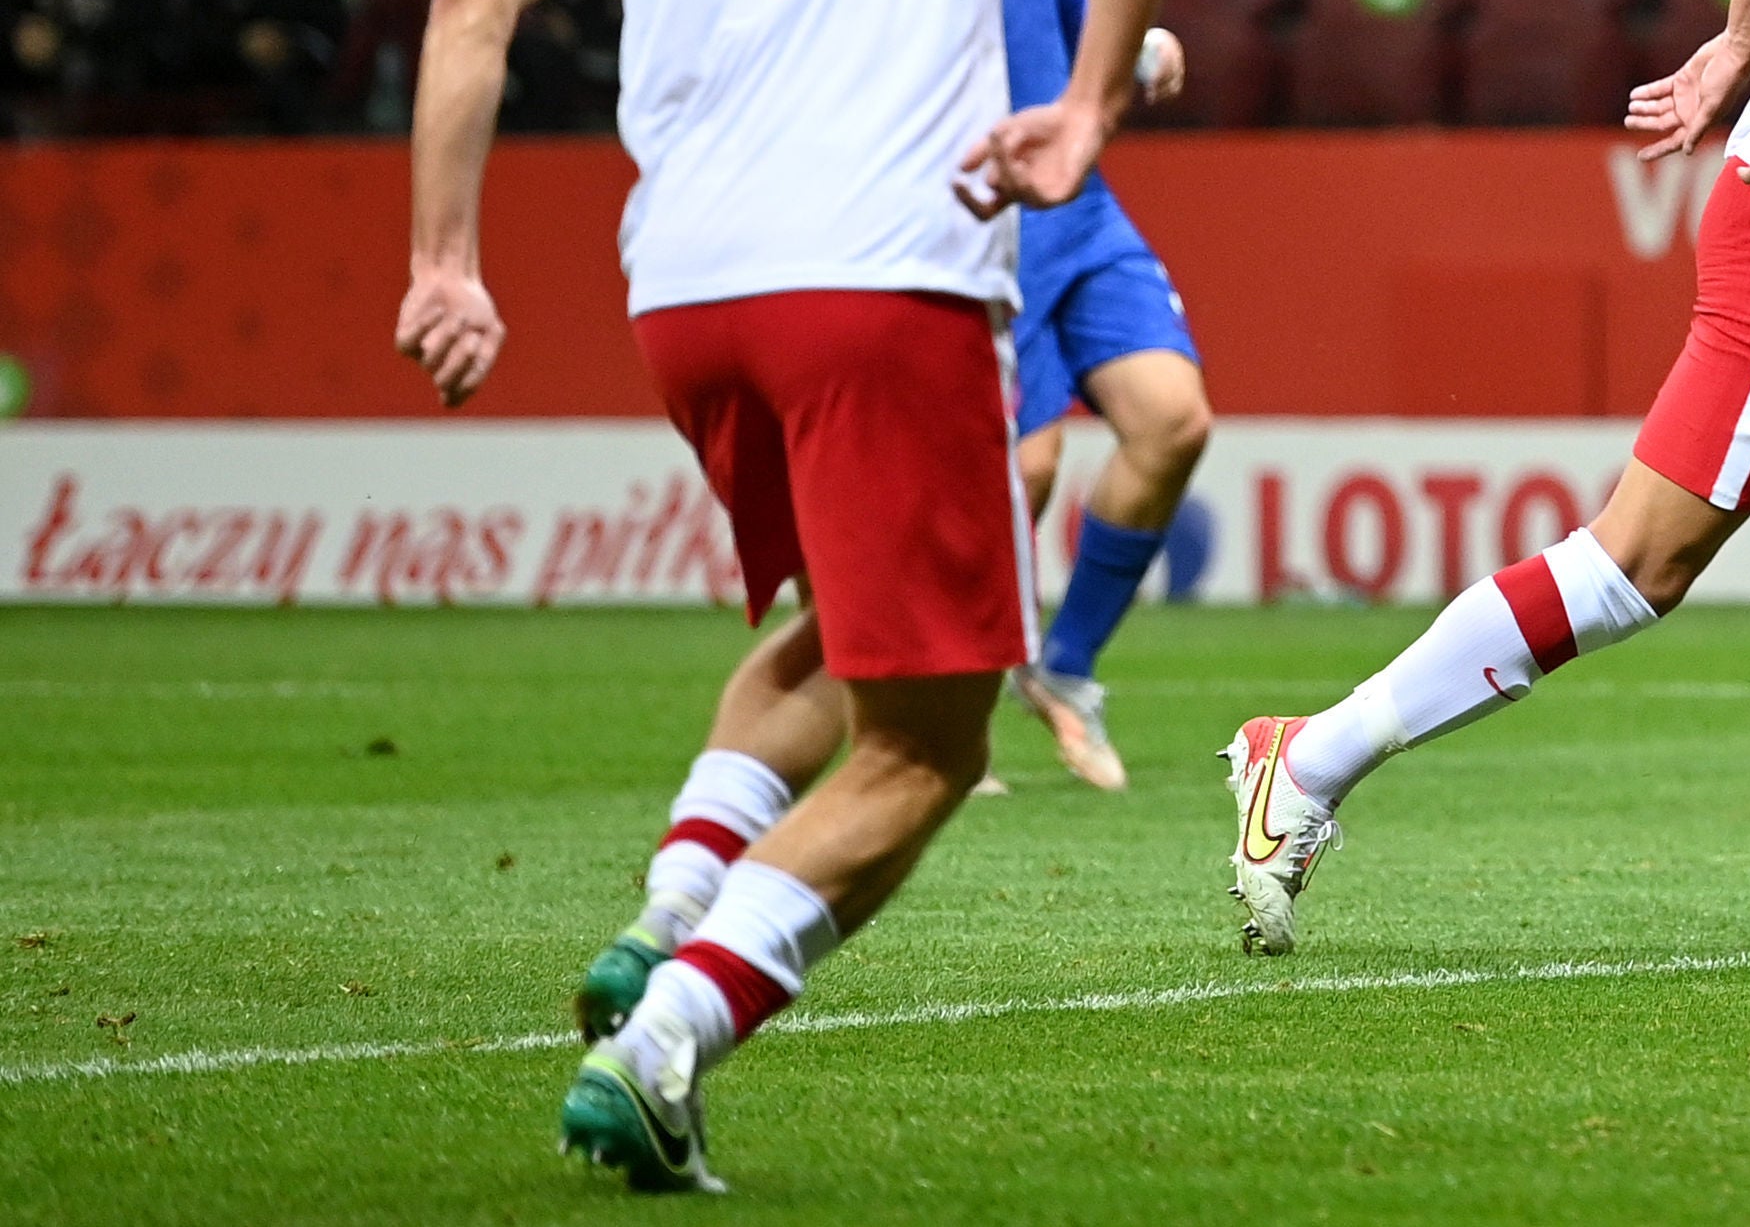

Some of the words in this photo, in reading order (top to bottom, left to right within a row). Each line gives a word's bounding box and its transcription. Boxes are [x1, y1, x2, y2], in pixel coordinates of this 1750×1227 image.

[336, 504, 527, 606] nas
[528, 472, 741, 606] piłk
[1252, 464, 1624, 604] LOTO
